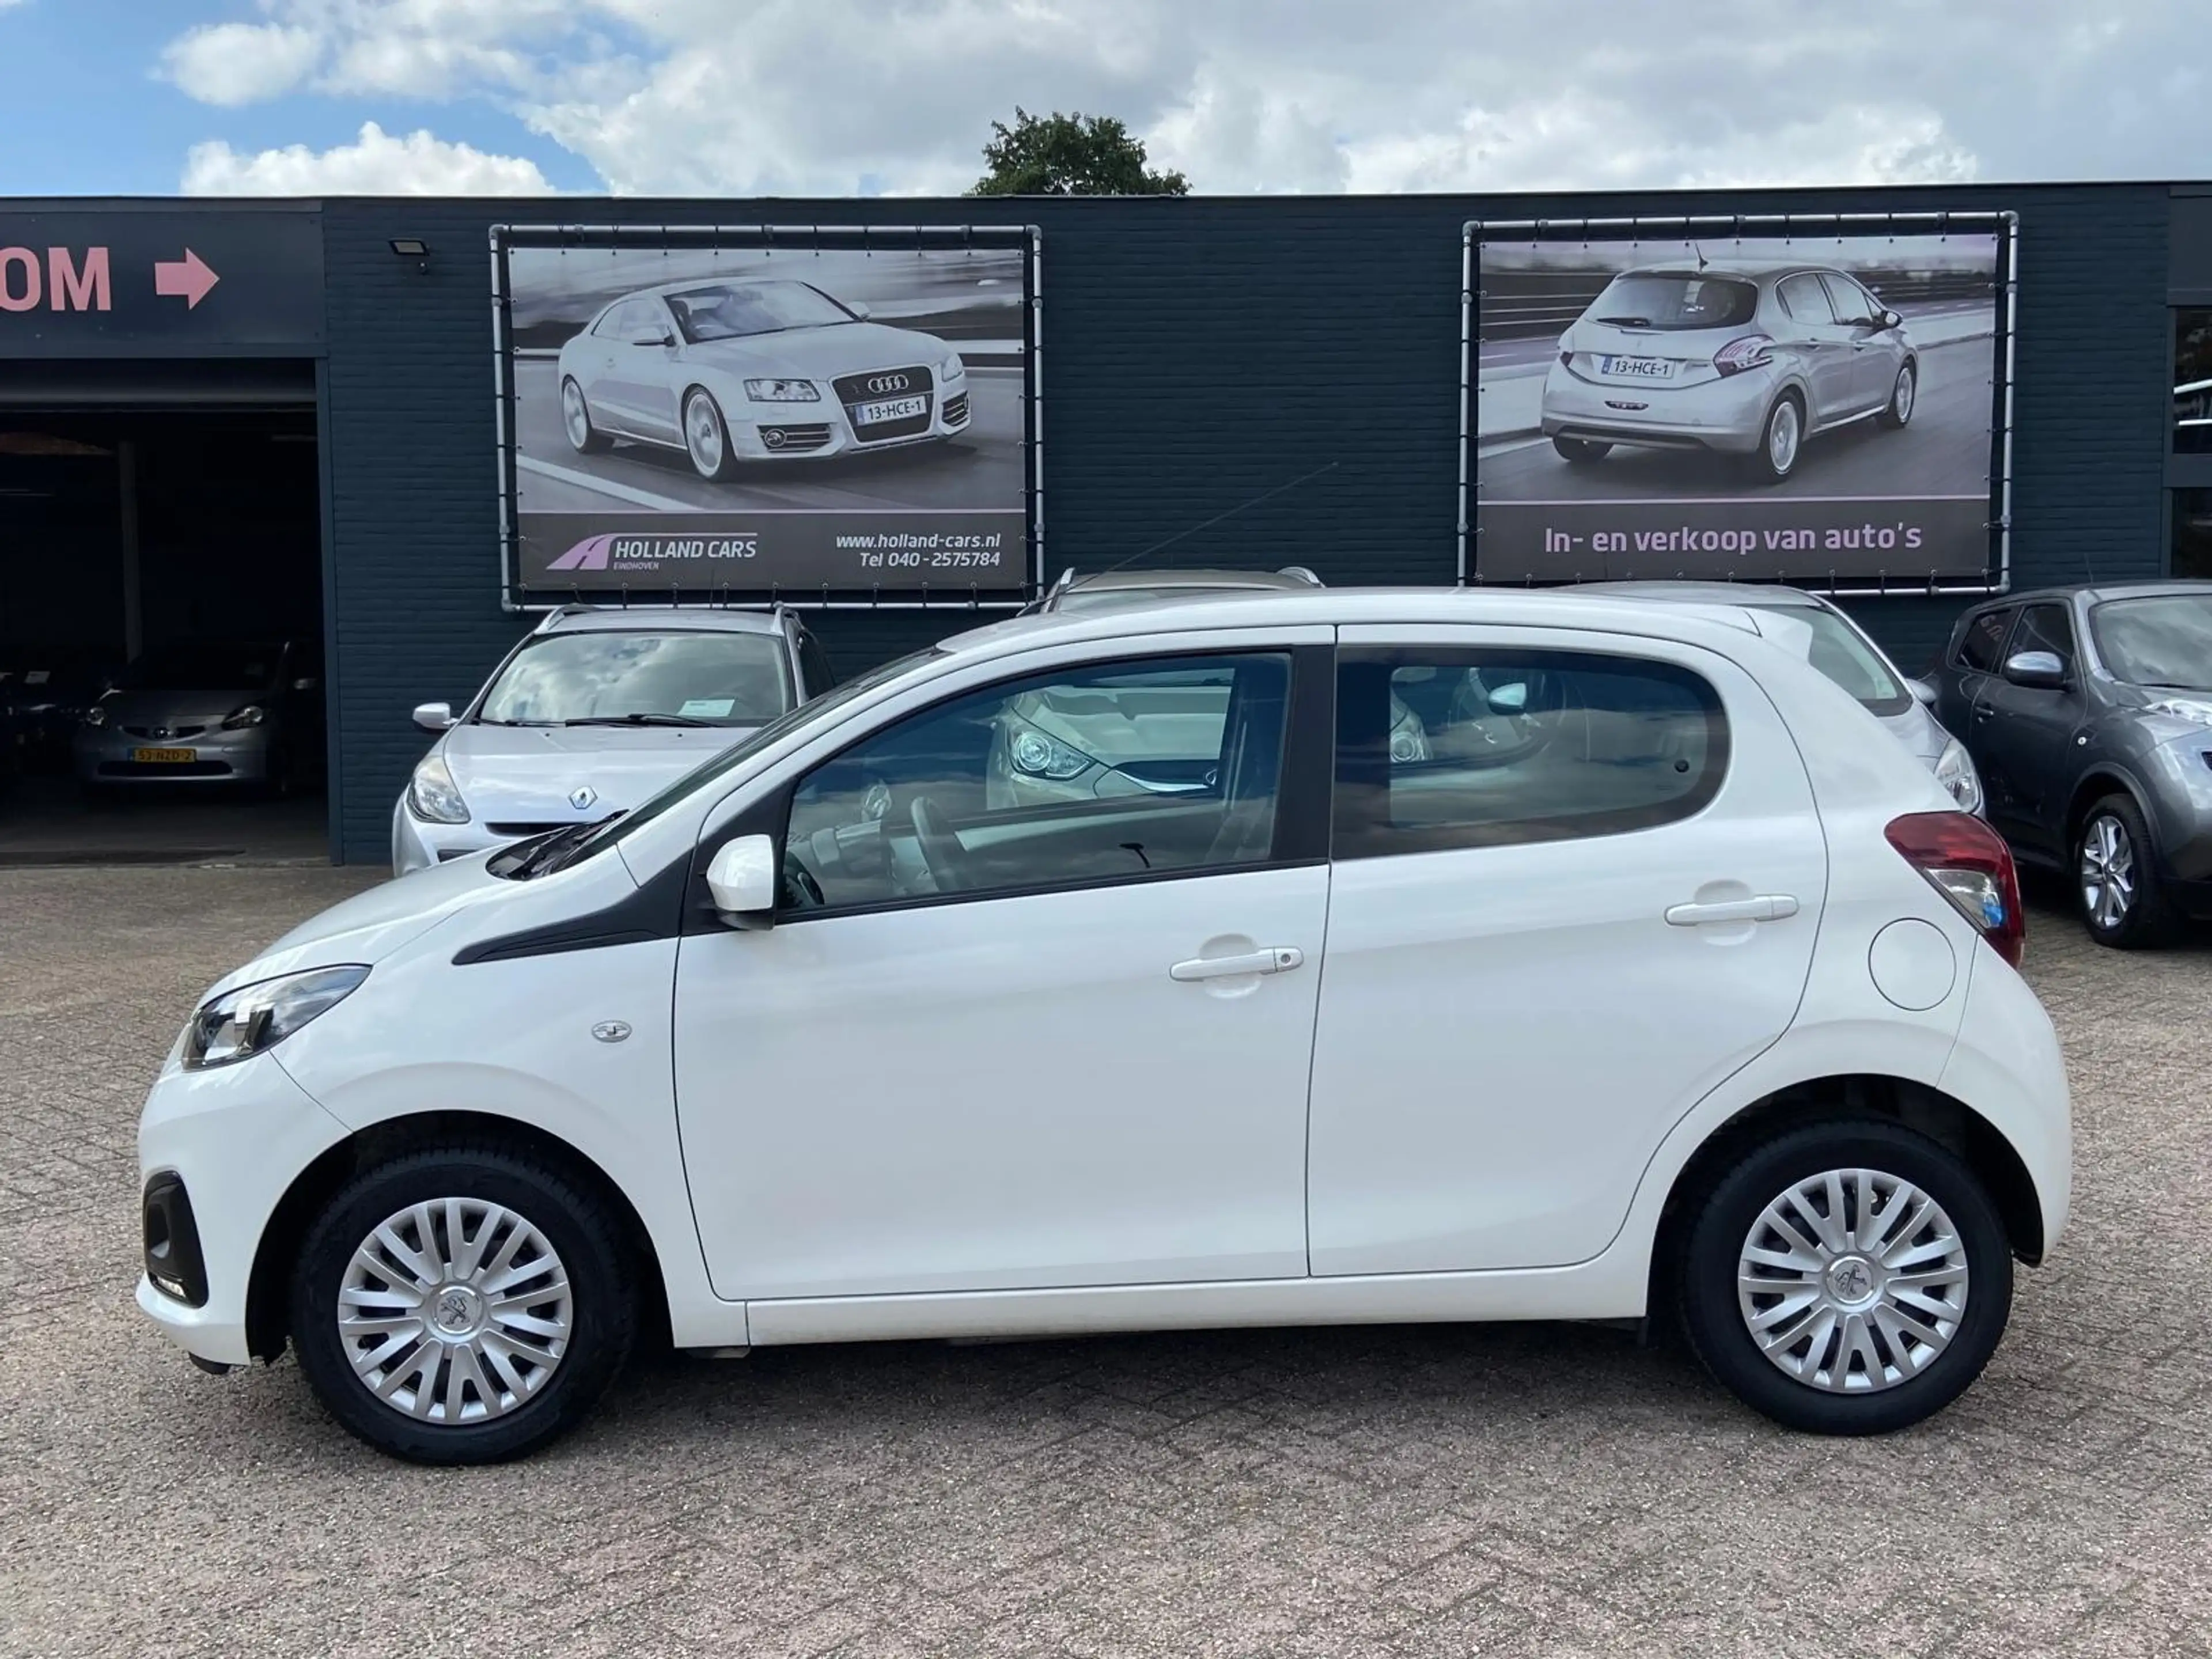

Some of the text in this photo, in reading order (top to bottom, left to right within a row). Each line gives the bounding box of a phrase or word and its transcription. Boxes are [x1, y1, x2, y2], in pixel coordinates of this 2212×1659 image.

[0, 247, 111, 312] OM
[1613, 359, 1669, 376] 13-HCE-1
[868, 400, 921, 421] 13-HCE-1
[836, 533, 1001, 548] www.holland-cars.nl
[1545, 522, 1921, 555] In- en verkoop van auto's
[615, 541, 757, 558] HOLLAND CARS
[613, 561, 660, 570] EINDHOVEN
[860, 552, 883, 567] Tel
